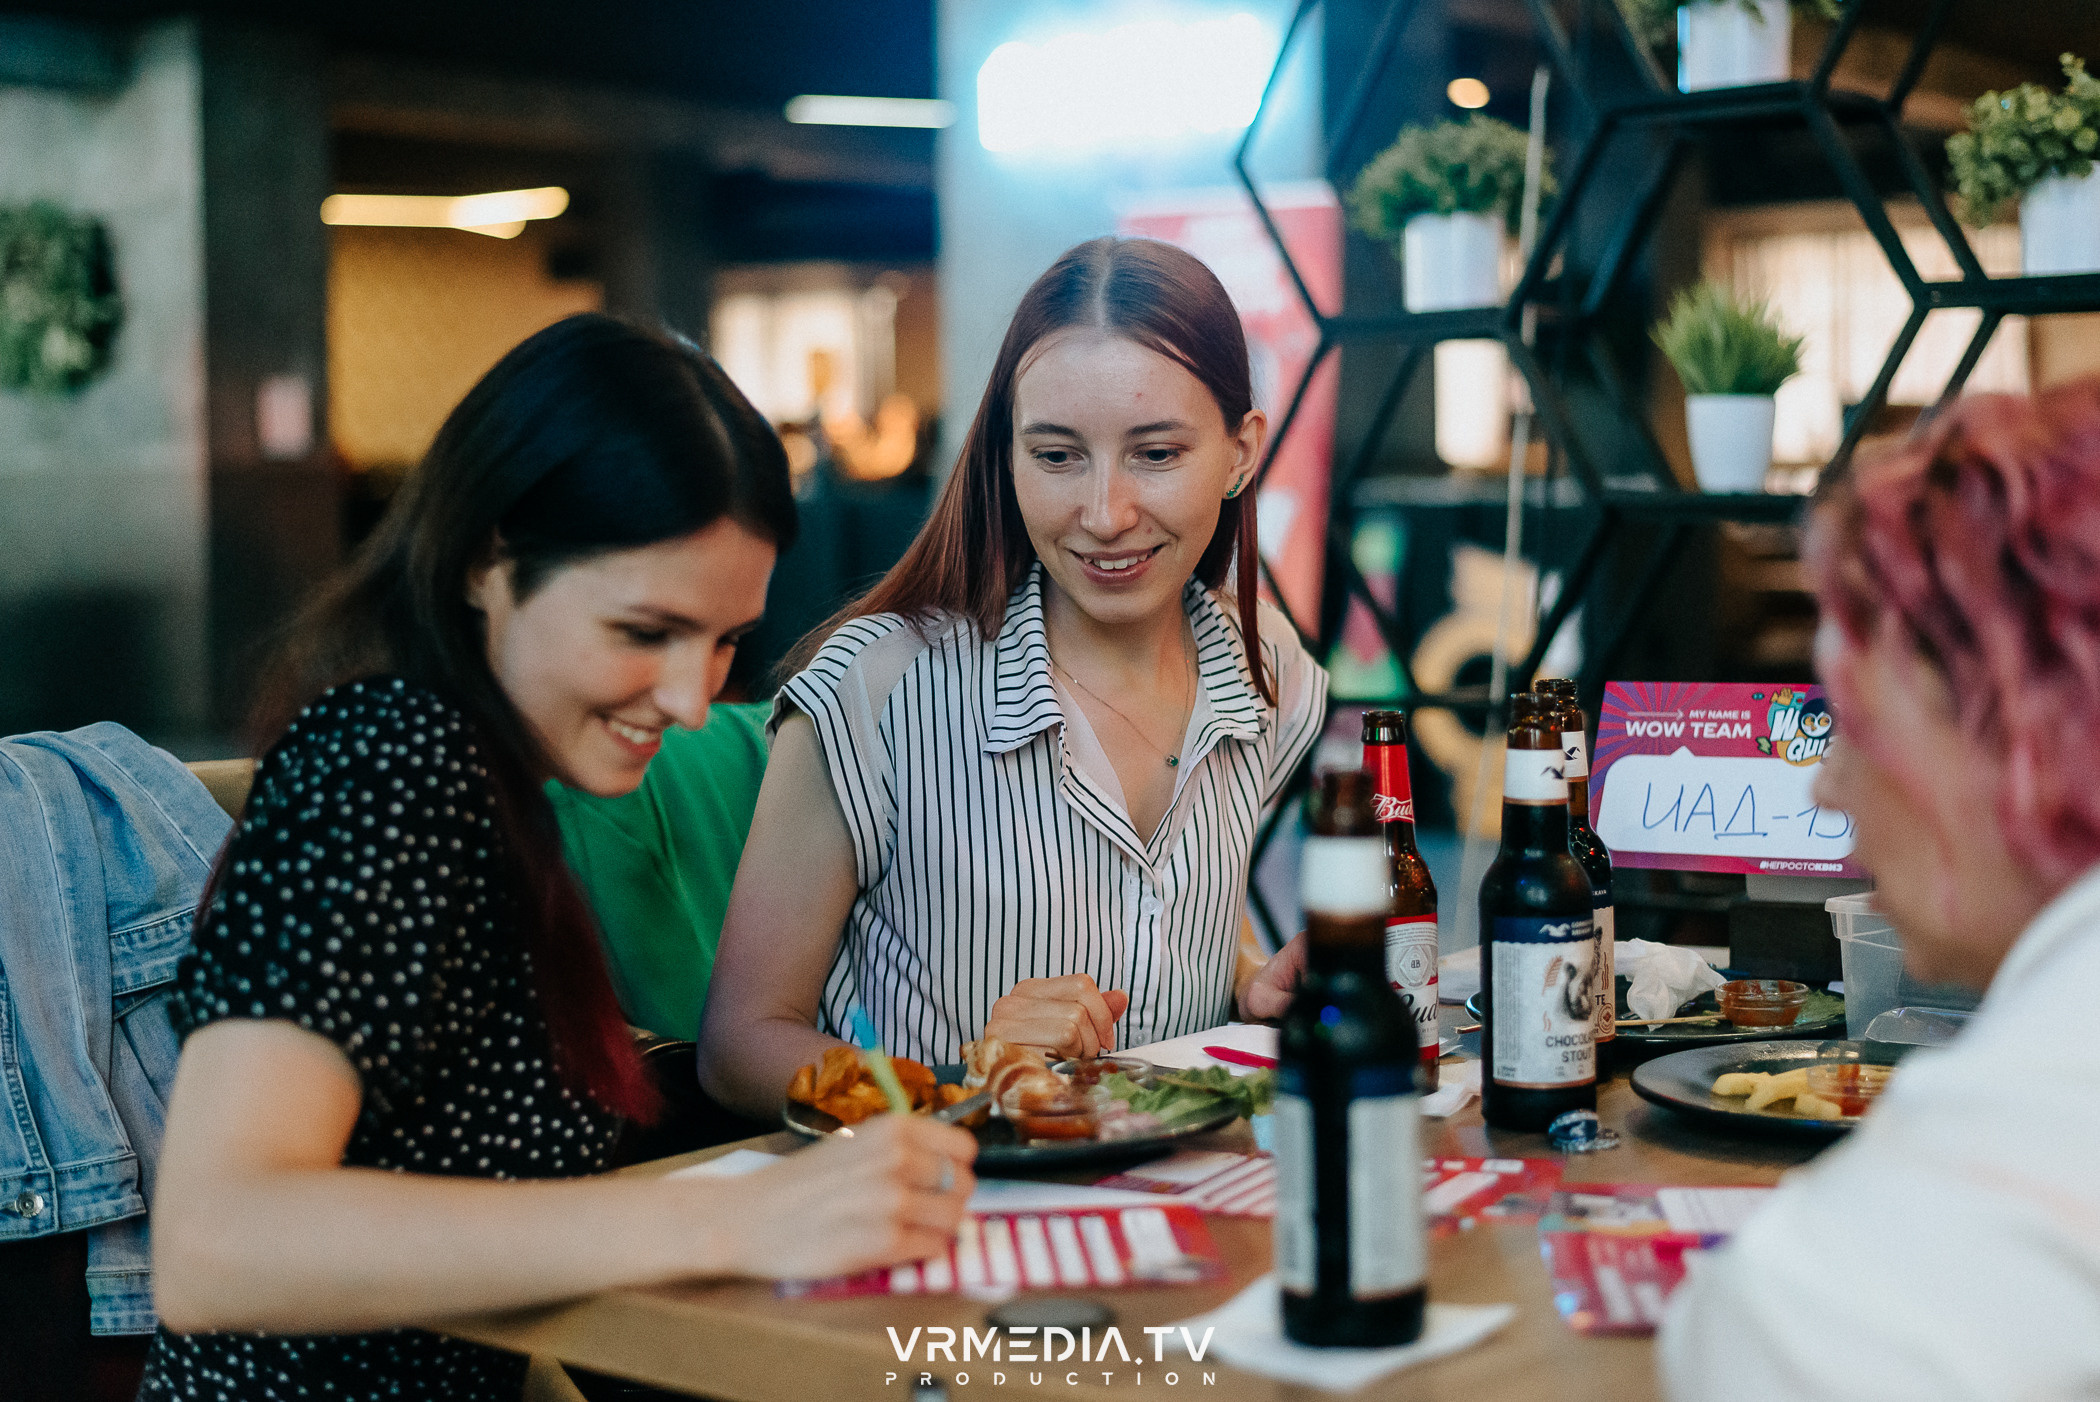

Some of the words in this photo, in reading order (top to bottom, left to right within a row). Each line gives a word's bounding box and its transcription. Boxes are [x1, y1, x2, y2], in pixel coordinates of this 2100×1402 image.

[1689, 710, 1707, 719] MY
[1708, 710, 1739, 719] NAME
[1741, 710, 1751, 720] IS
[1625, 720, 1685, 738] WOW
[1690, 722, 1752, 739] TEAM
[1759, 861, 1843, 872] #НЕПРОСТОКВИЗ
